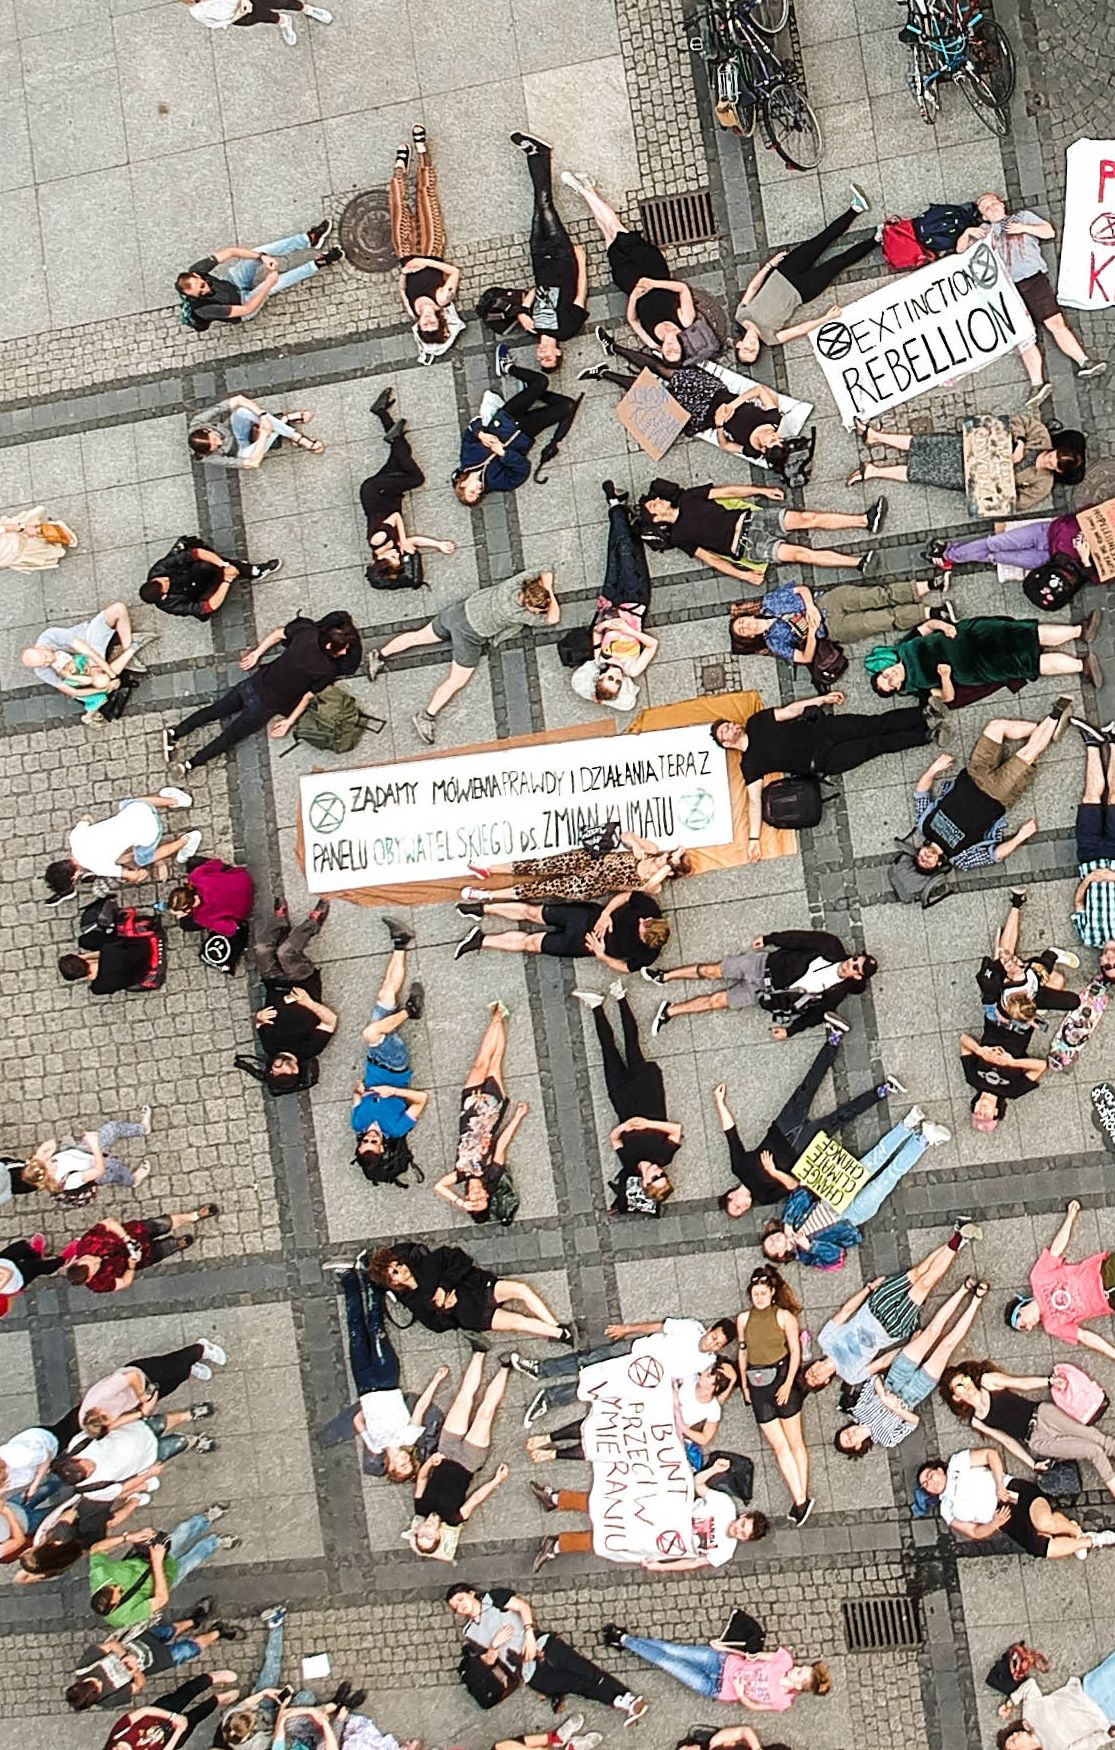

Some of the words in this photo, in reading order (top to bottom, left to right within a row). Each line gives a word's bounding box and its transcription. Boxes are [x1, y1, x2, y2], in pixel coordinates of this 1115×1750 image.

[850, 269, 977, 353] EXTINCTION
[843, 292, 1016, 412] REBELLION
[502, 770, 565, 796] PRAWDY
[571, 771, 575, 793] I
[580, 760, 659, 792] DZIAŁANIA
[658, 751, 712, 778] TERAZ
[313, 839, 368, 873] PANELU
[373, 820, 514, 867] OBYWATELSKIEGO
[543, 803, 599, 847] ZMIAN
[798, 1159, 844, 1206] CHANGE
[807, 1143, 857, 1193] CLIMATE
[818, 1140, 864, 1179] CHANGE
[587, 1380, 629, 1552] WYMIERANIU
[622, 1402, 658, 1526] PRZECIW
[650, 1423, 688, 1503] BUNT
